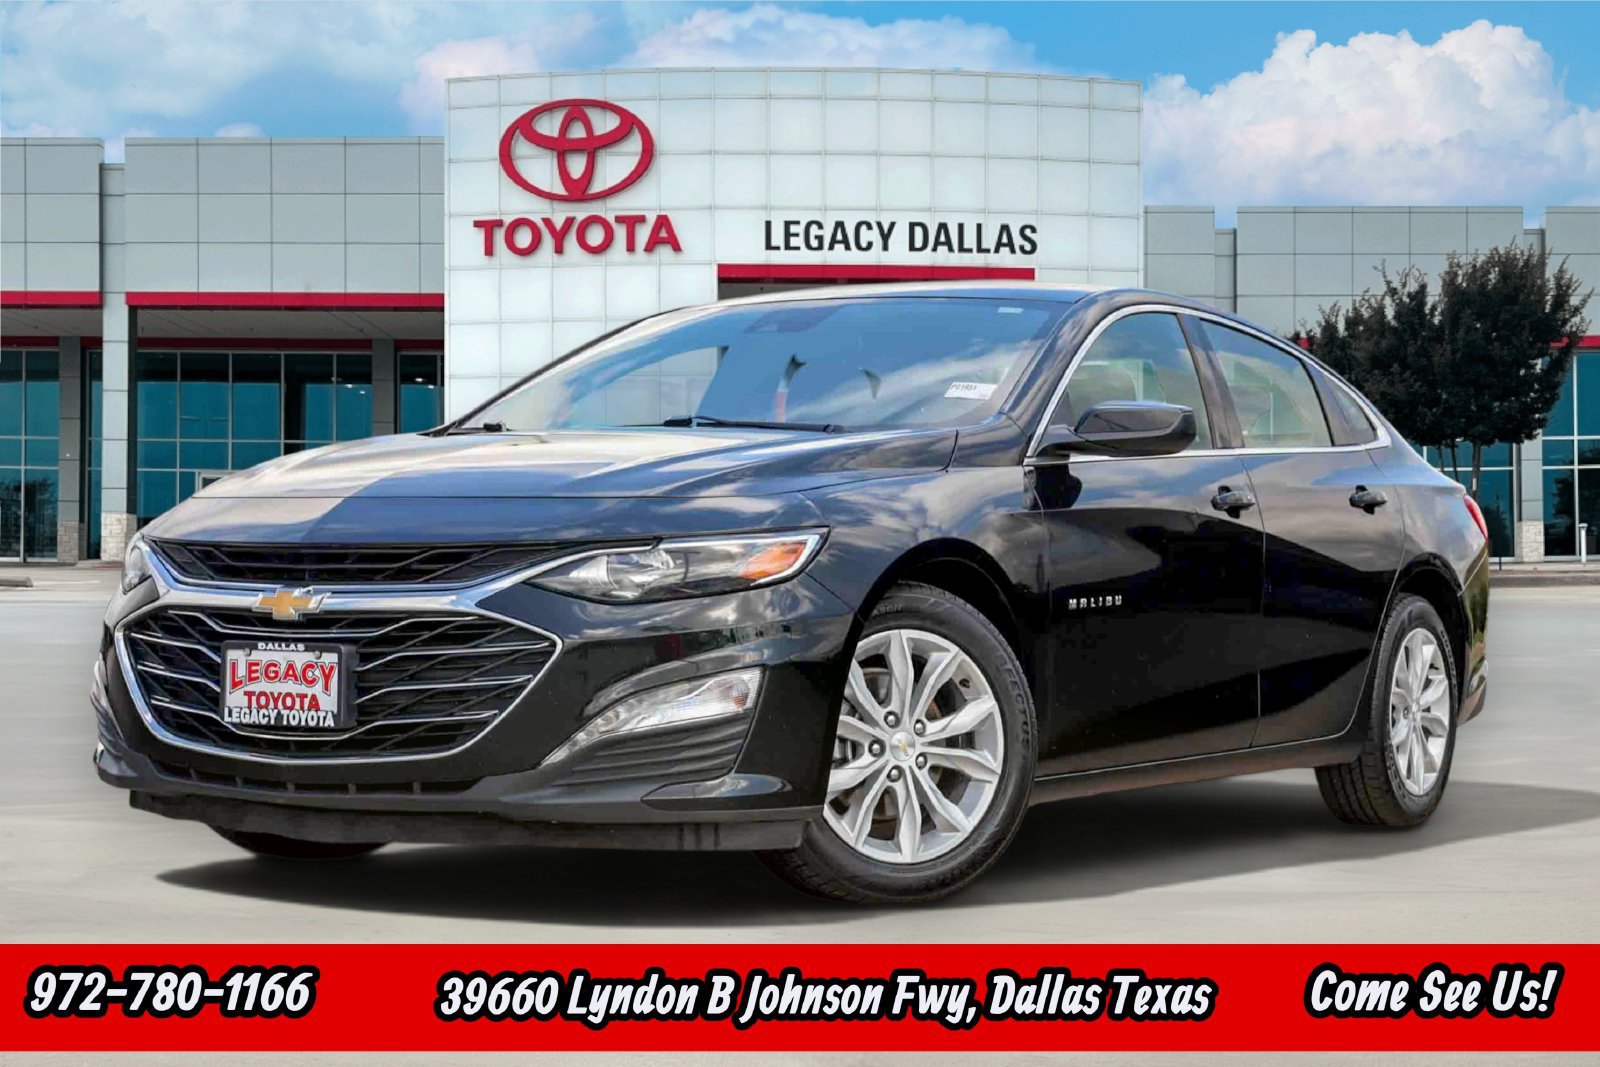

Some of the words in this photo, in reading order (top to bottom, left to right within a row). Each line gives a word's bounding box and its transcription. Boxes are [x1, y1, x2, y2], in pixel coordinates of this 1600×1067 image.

[473, 213, 682, 257] TOYOTA
[765, 220, 896, 252] LEGACY
[908, 221, 1038, 255] DALLAS
[1068, 595, 1123, 610] MALIBU
[257, 641, 306, 651] DALLAS
[228, 658, 338, 697] LEGACY
[243, 690, 321, 711] TOYOTA
[223, 706, 278, 725] LEGACY
[280, 709, 335, 728] TOYOTA
